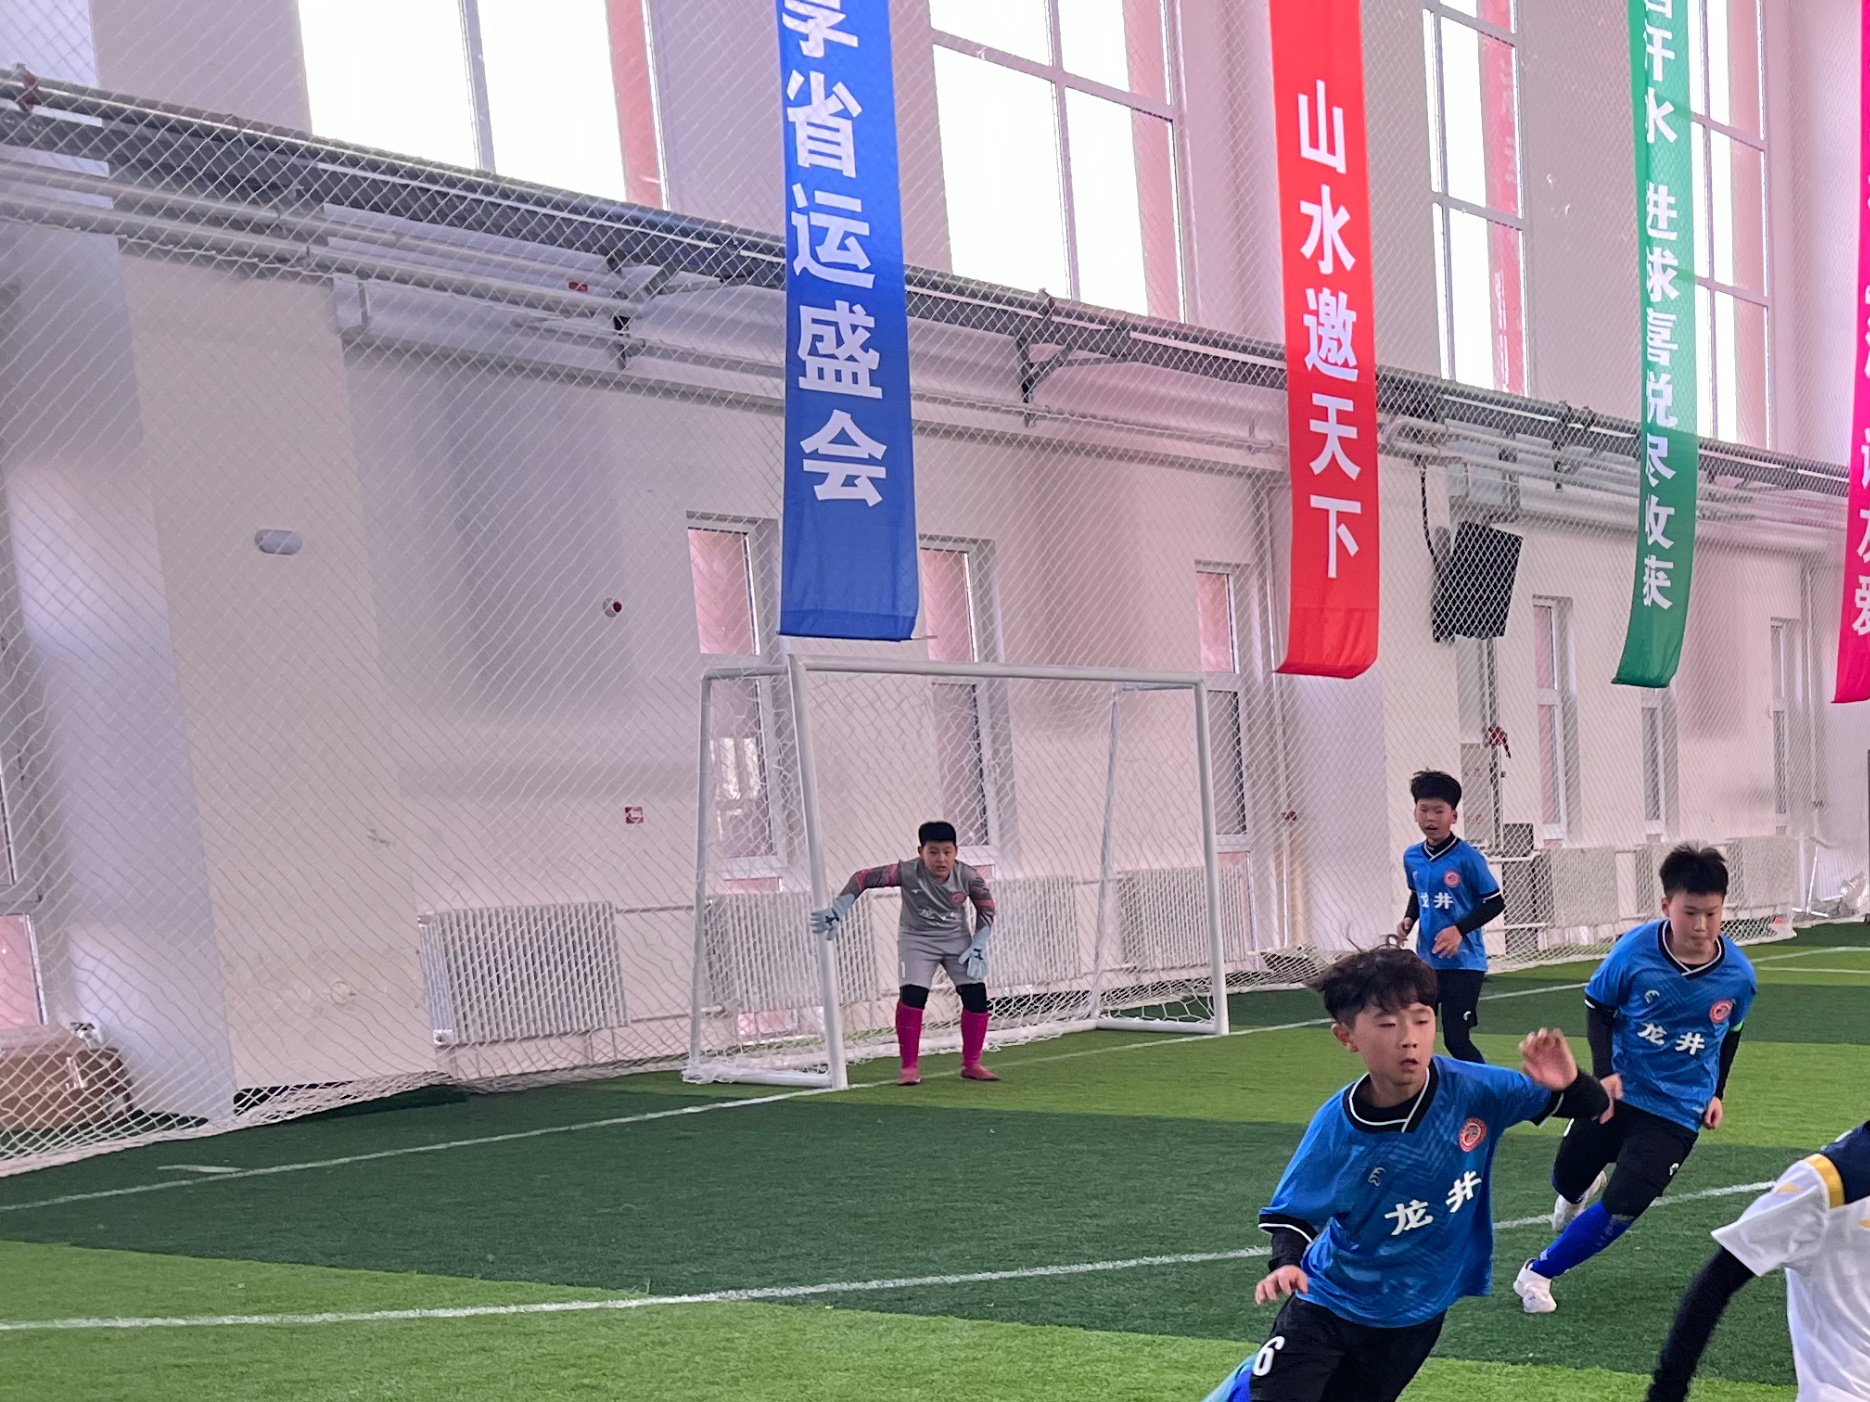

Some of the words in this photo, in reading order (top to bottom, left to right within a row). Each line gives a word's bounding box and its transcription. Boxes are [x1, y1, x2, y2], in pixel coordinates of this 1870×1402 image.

[1297, 79, 1362, 580] 山水邀天下
[1636, 1021, 1706, 1056] 龙井
[1384, 1170, 1482, 1236] 龙井
[1252, 1335, 1286, 1378] 6
